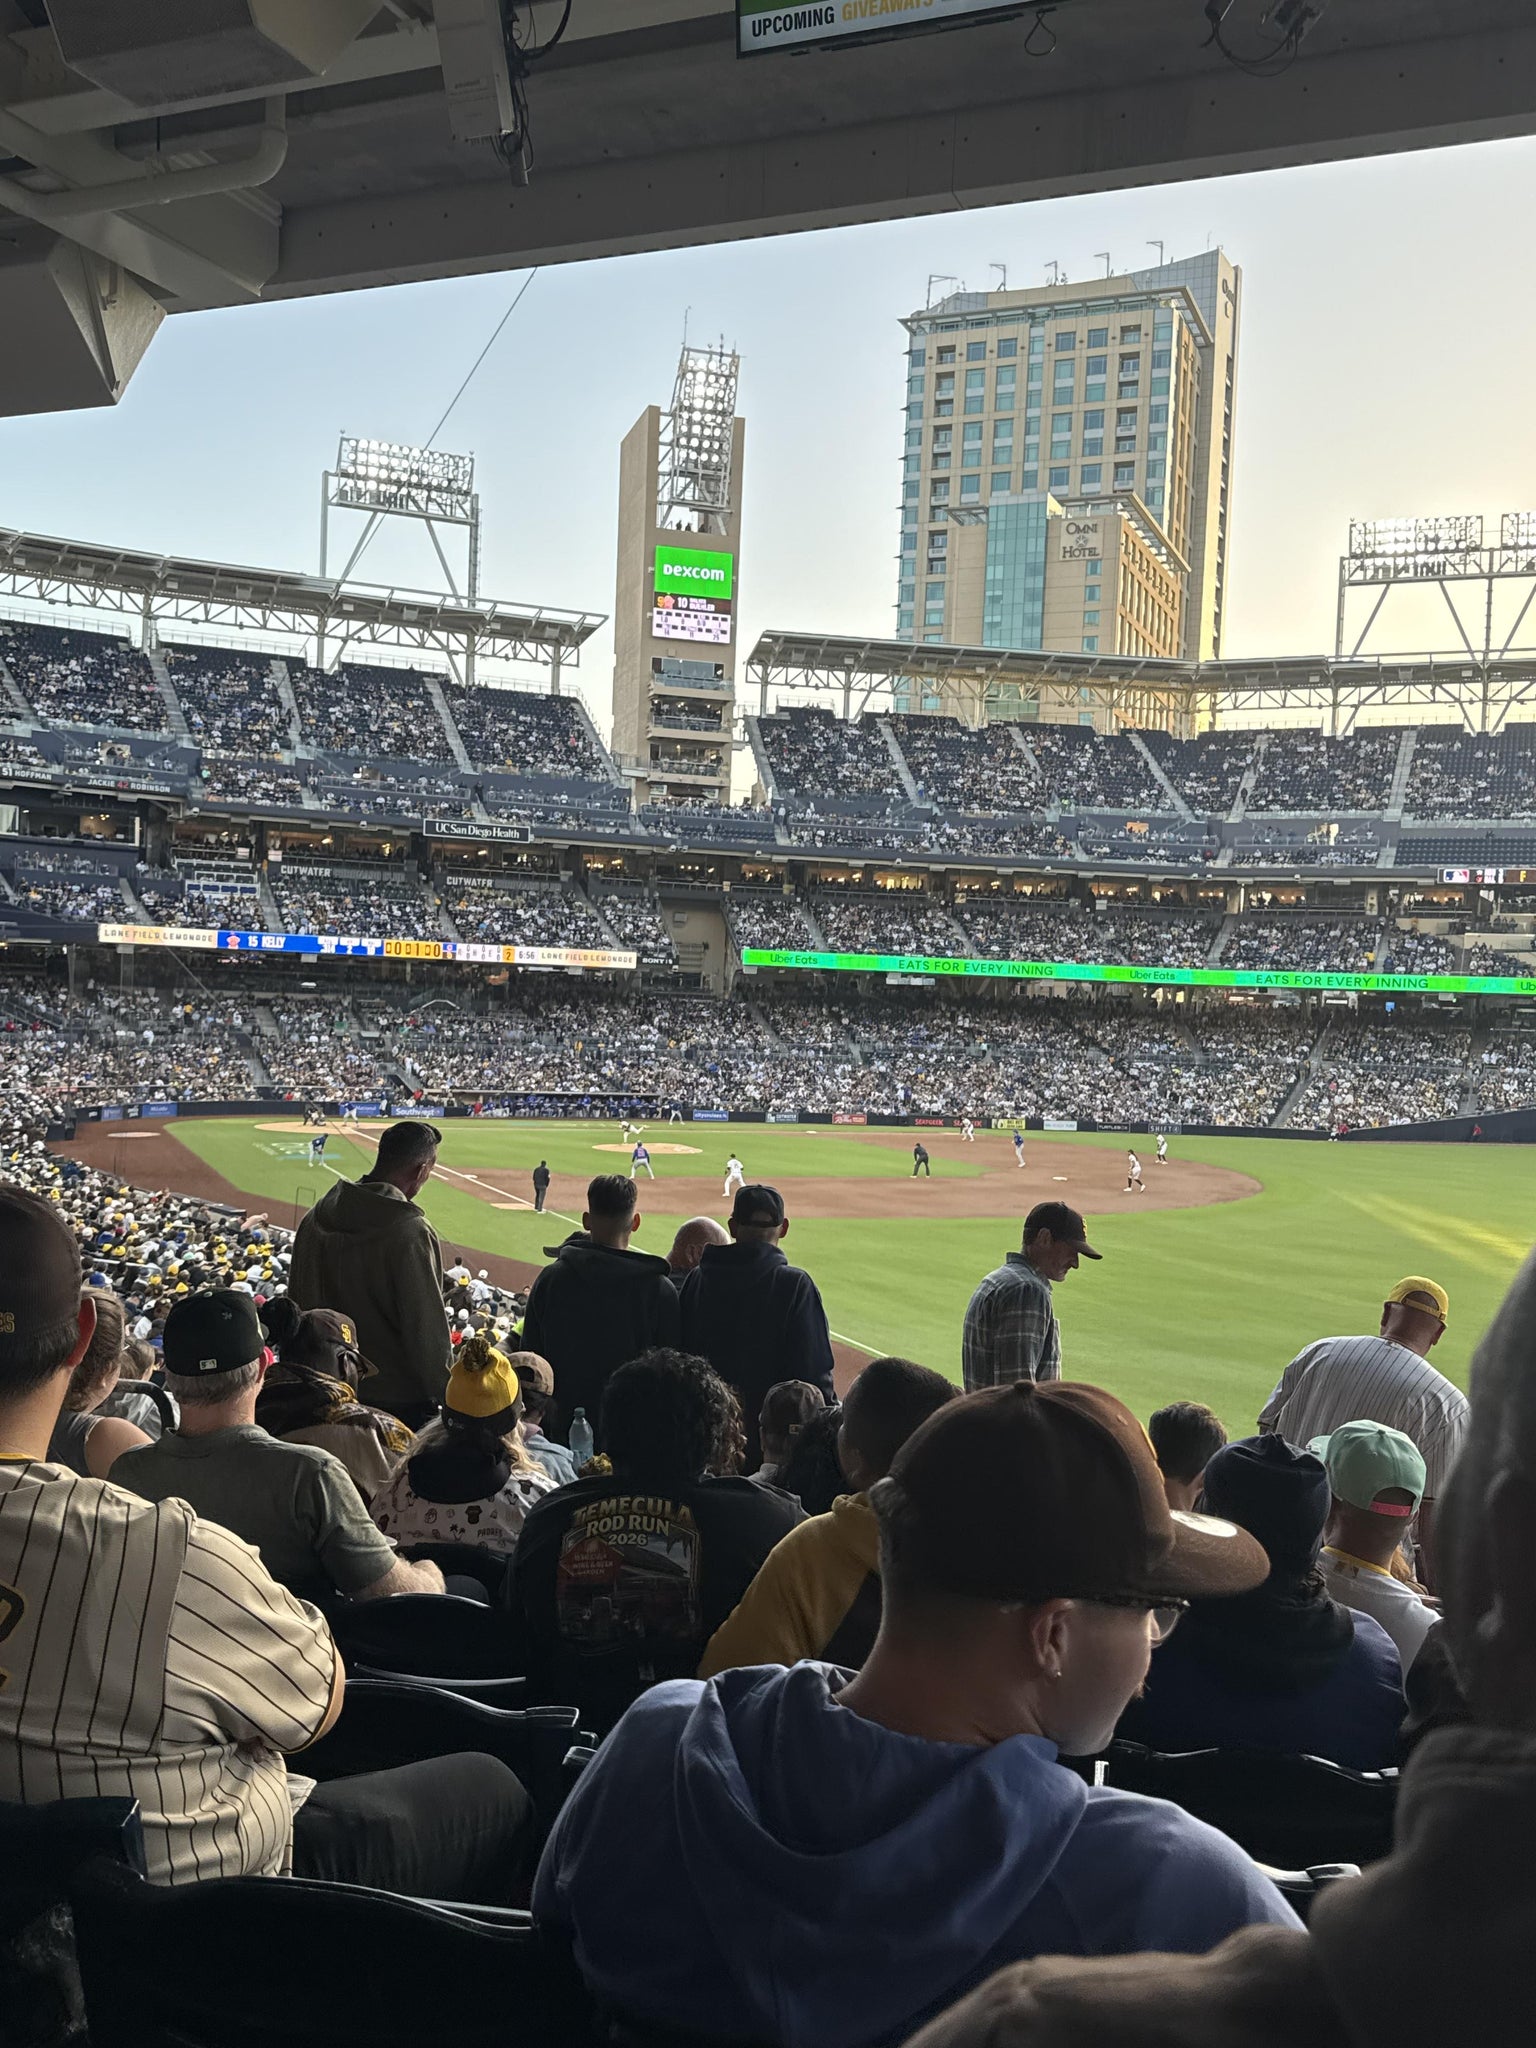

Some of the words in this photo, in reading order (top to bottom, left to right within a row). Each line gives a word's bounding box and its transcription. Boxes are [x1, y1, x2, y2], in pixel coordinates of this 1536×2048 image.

[752, 6, 835, 37] UPCOMING
[677, 597, 688, 609] 10
[2, 767, 13, 777] 51
[14, 769, 52, 780] HOFFMAN
[88, 778, 115, 788] JACKIE
[116, 780, 129, 789] 42
[130, 782, 171, 793] ROBINSON
[436, 823, 450, 833] UC
[450, 824, 467, 835] San
[468, 826, 492, 838] Diego
[493, 827, 520, 839] Health
[280, 864, 332, 878] CUTWATER
[446, 876, 494, 888] CUTWATER
[518, 951, 535, 960] 6:56
[770, 953, 793, 964] Uber
[795, 954, 818, 965] Eats
[899, 959, 930, 970] EATS
[934, 961, 960, 972] FOR
[964, 963, 1003, 974] EVERY
[1008, 964, 1053, 976] INNING
[1129, 970, 1151, 979] Uber
[1153, 971, 1175, 980] Eats
[1256, 974, 1290, 985] EATS
[1294, 975, 1319, 986] FOR
[1327, 976, 1370, 988] EVERY
[1376, 977, 1429, 989] INNING
[395, 1108, 435, 1117] Southwest
[915, 1118, 944, 1126] SEATGEEK
[573, 1496, 693, 1521] TEMECULA
[586, 1515, 626, 1537] ROD
[629, 1514, 670, 1536] RUN
[608, 1533, 648, 1546] 2026
